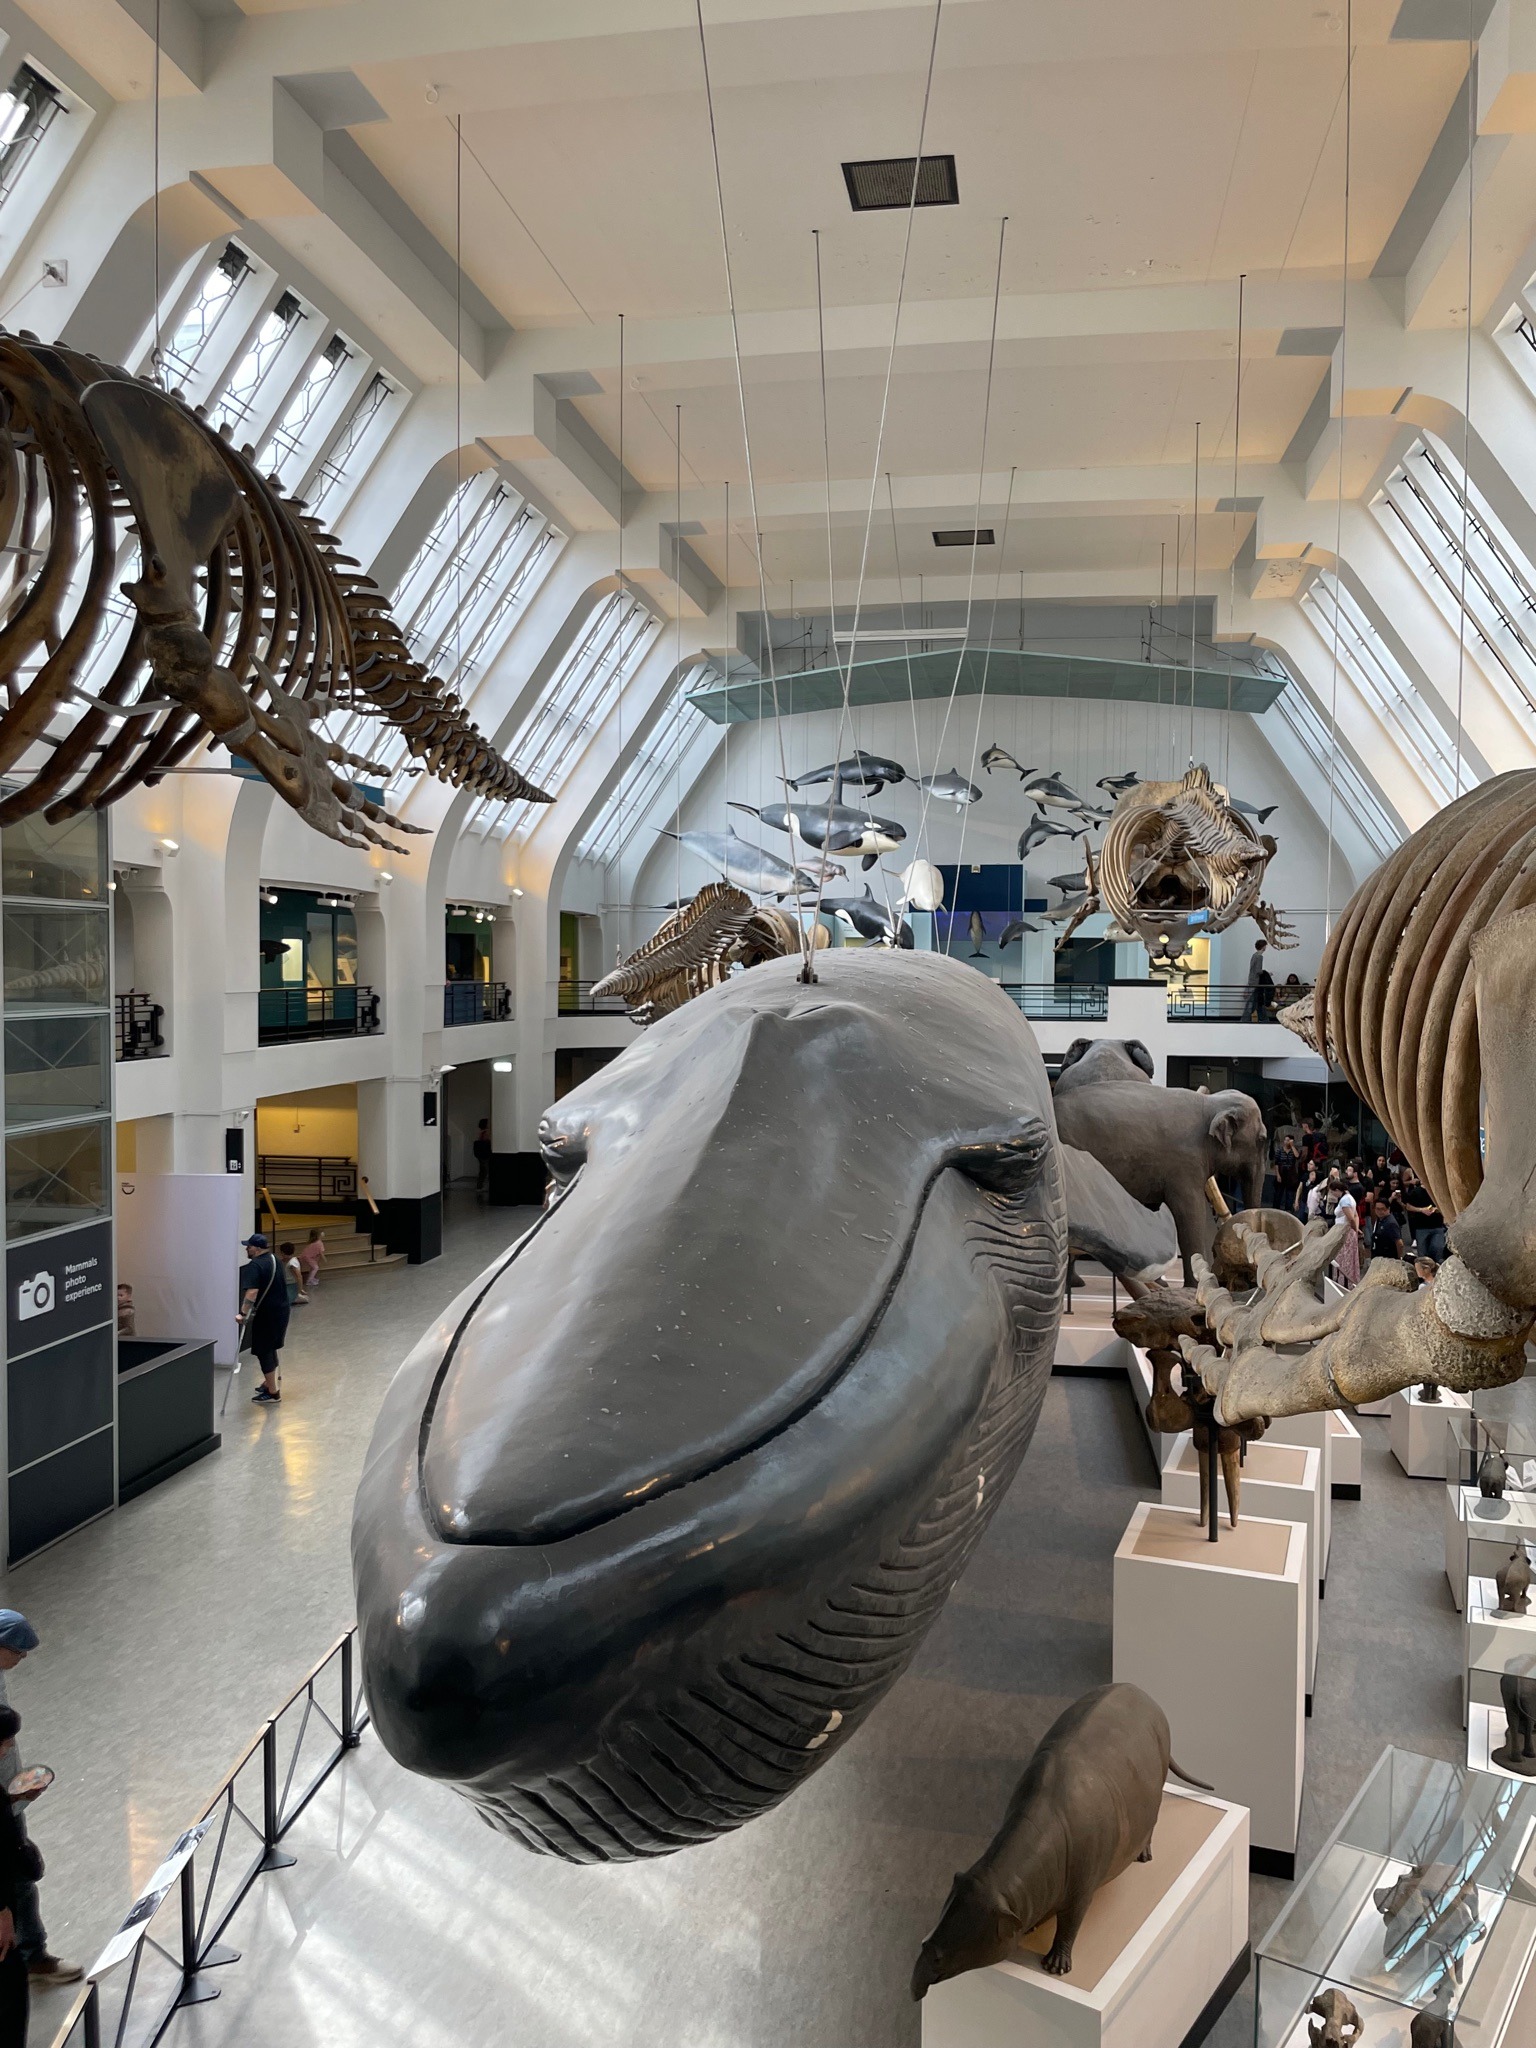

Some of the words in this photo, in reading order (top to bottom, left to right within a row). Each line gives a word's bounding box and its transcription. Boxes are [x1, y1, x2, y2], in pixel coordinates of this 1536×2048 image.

[65, 1257, 98, 1275] Mammals
[65, 1275, 87, 1291] photo
[65, 1283, 103, 1302] experience
